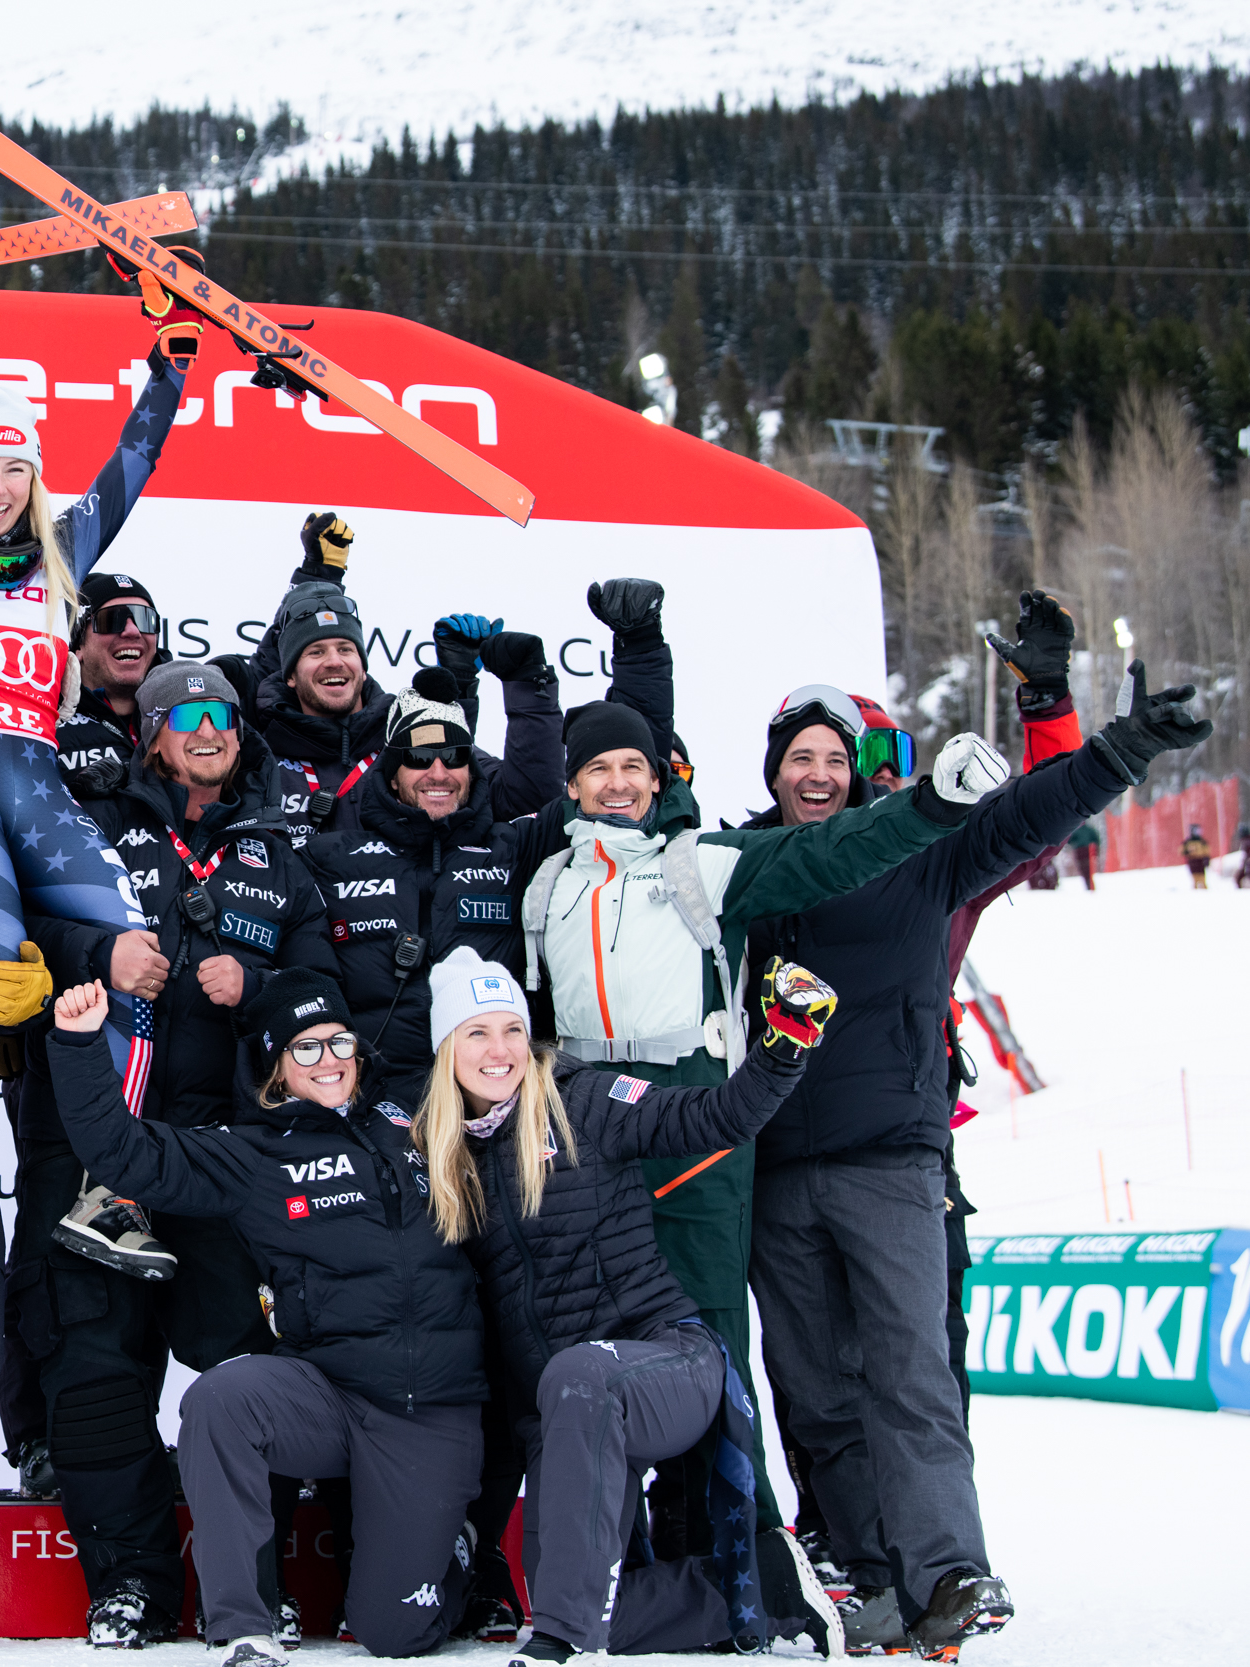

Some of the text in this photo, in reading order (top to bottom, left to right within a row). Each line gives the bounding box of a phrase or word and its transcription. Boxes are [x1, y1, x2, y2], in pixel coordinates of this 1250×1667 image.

[60, 188, 328, 378] MIKAELA & ATOMIC
[161, 617, 211, 659] IS
[281, 793, 310, 814] ISA
[132, 868, 160, 891] SA
[451, 866, 510, 885] xfinity
[224, 880, 287, 909] xfinity
[333, 878, 396, 899] VISA
[459, 898, 510, 920] STIFEL
[221, 912, 275, 949] STIFEL
[349, 918, 398, 933] TOYOTA
[294, 1001, 321, 1018] RIEDEL
[280, 1153, 356, 1184] VISA
[311, 1191, 367, 1210] TOYOTA
[11, 1530, 79, 1560] FIS
